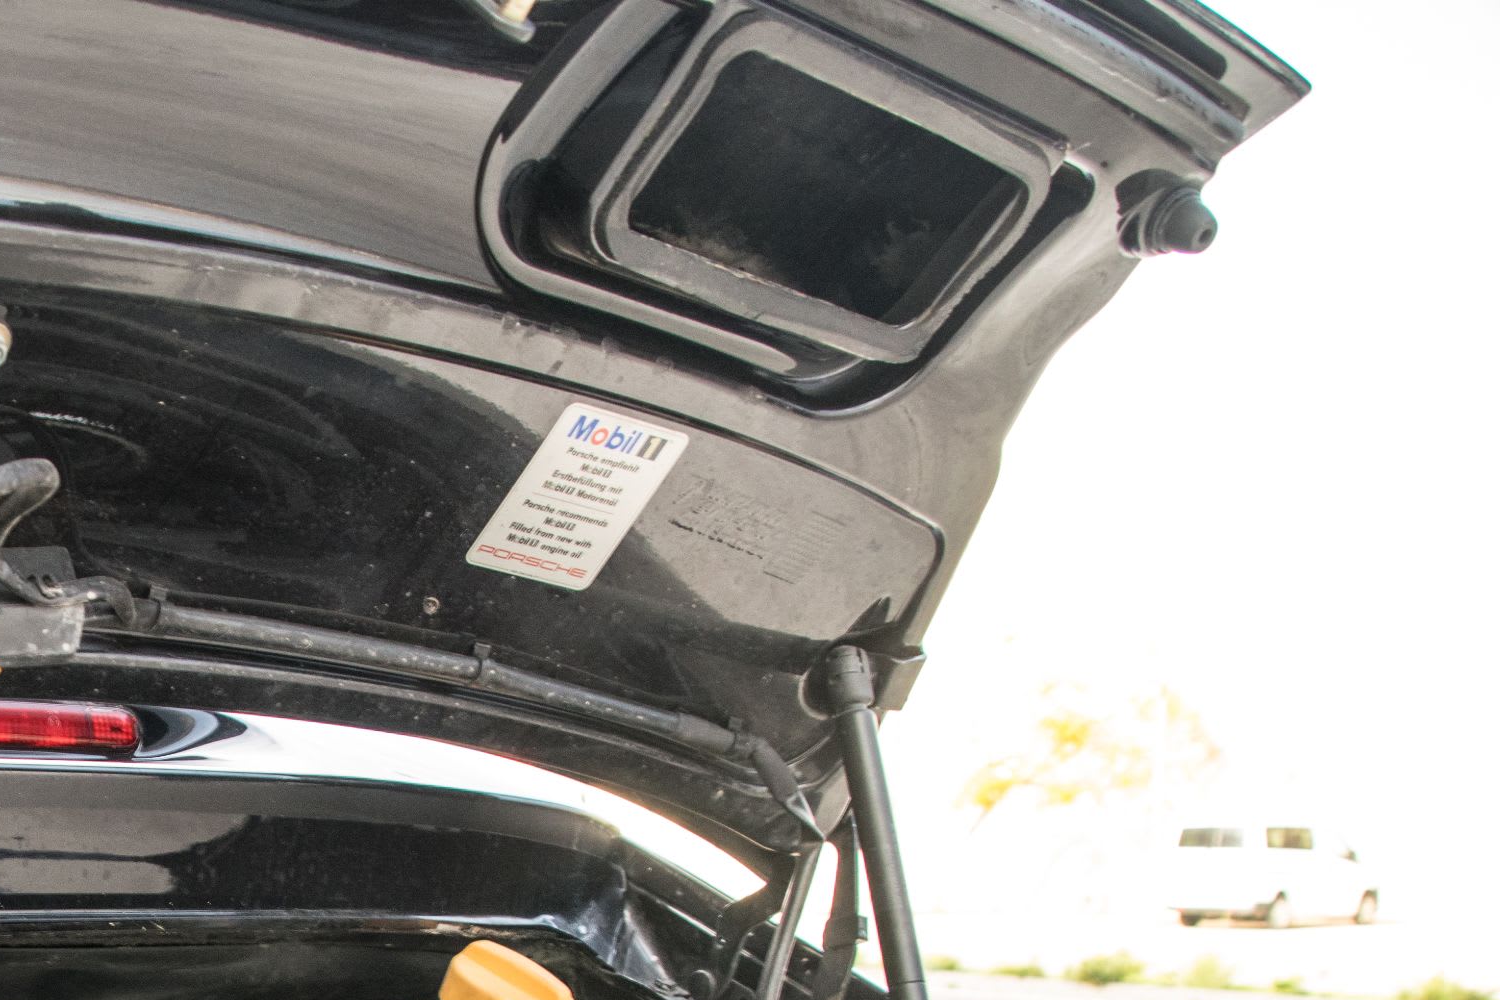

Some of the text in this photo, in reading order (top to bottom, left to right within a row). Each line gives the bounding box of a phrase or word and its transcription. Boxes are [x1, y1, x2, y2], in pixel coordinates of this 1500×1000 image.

[568, 415, 642, 453] Mobil
[566, 447, 599, 463] Porsche
[522, 499, 609, 528] Porsche recommends
[509, 521, 592, 549] Filled from new with
[477, 544, 588, 579] PORSCHE
[540, 542, 569, 556] engine
[569, 549, 583, 560] oil
